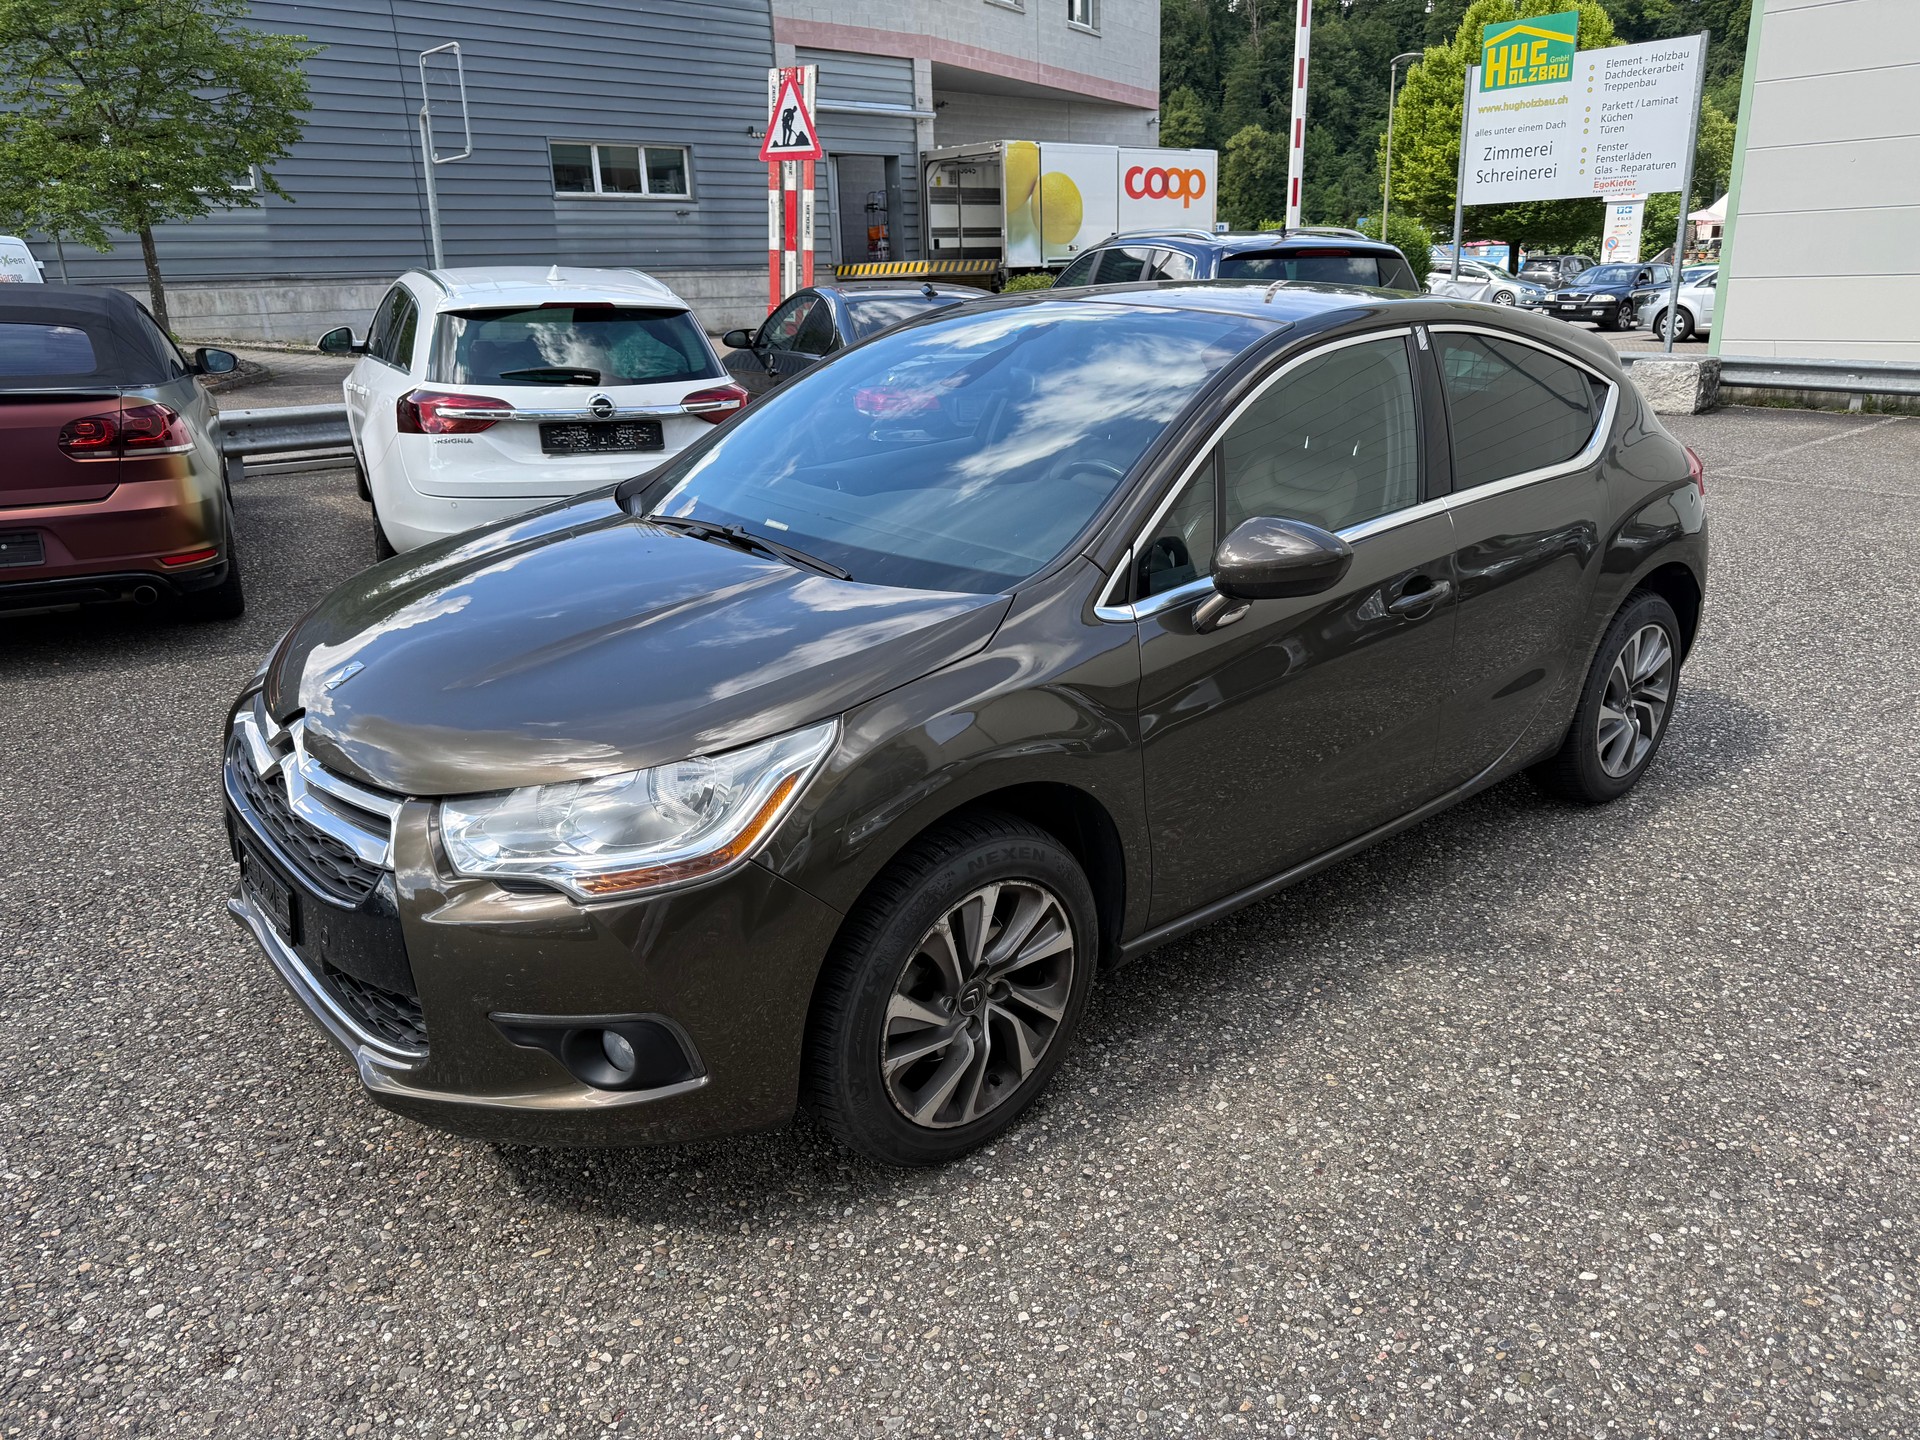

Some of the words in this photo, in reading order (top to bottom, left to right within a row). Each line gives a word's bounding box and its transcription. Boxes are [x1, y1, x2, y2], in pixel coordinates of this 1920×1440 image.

[1485, 40, 1548, 88] HUG
[1550, 55, 1570, 63] GmbH
[1606, 56, 1643, 69] Element
[1651, 51, 1690, 63] Holzbau
[1605, 62, 1685, 80] Dachdeckerarbeit
[1604, 79, 1657, 92] Treppenbau
[1478, 95, 1569, 114] www.hugholzbau.ch
[1601, 101, 1634, 111] Parkett
[1641, 96, 1679, 107] Laminat
[1600, 112, 1633, 123] Küchen
[1475, 128, 1493, 137] alles
[1494, 126, 1516, 135] unter
[1517, 124, 1544, 132] einem
[1545, 120, 1567, 130] Dach
[1600, 125, 1625, 134] Türen
[1483, 140, 1553, 161] Zimmerei
[1597, 142, 1629, 152] Fenster
[1595, 151, 1652, 163] Fensterläden
[1476, 163, 1558, 184] Schreinerei
[1594, 165, 1613, 175] Glas
[1620, 161, 1677, 174] Reparaturen
[1124, 166, 1206, 209] coop
[1593, 179, 1637, 190] EgoKiefer
[967, 847, 1046, 873] NEXEN
